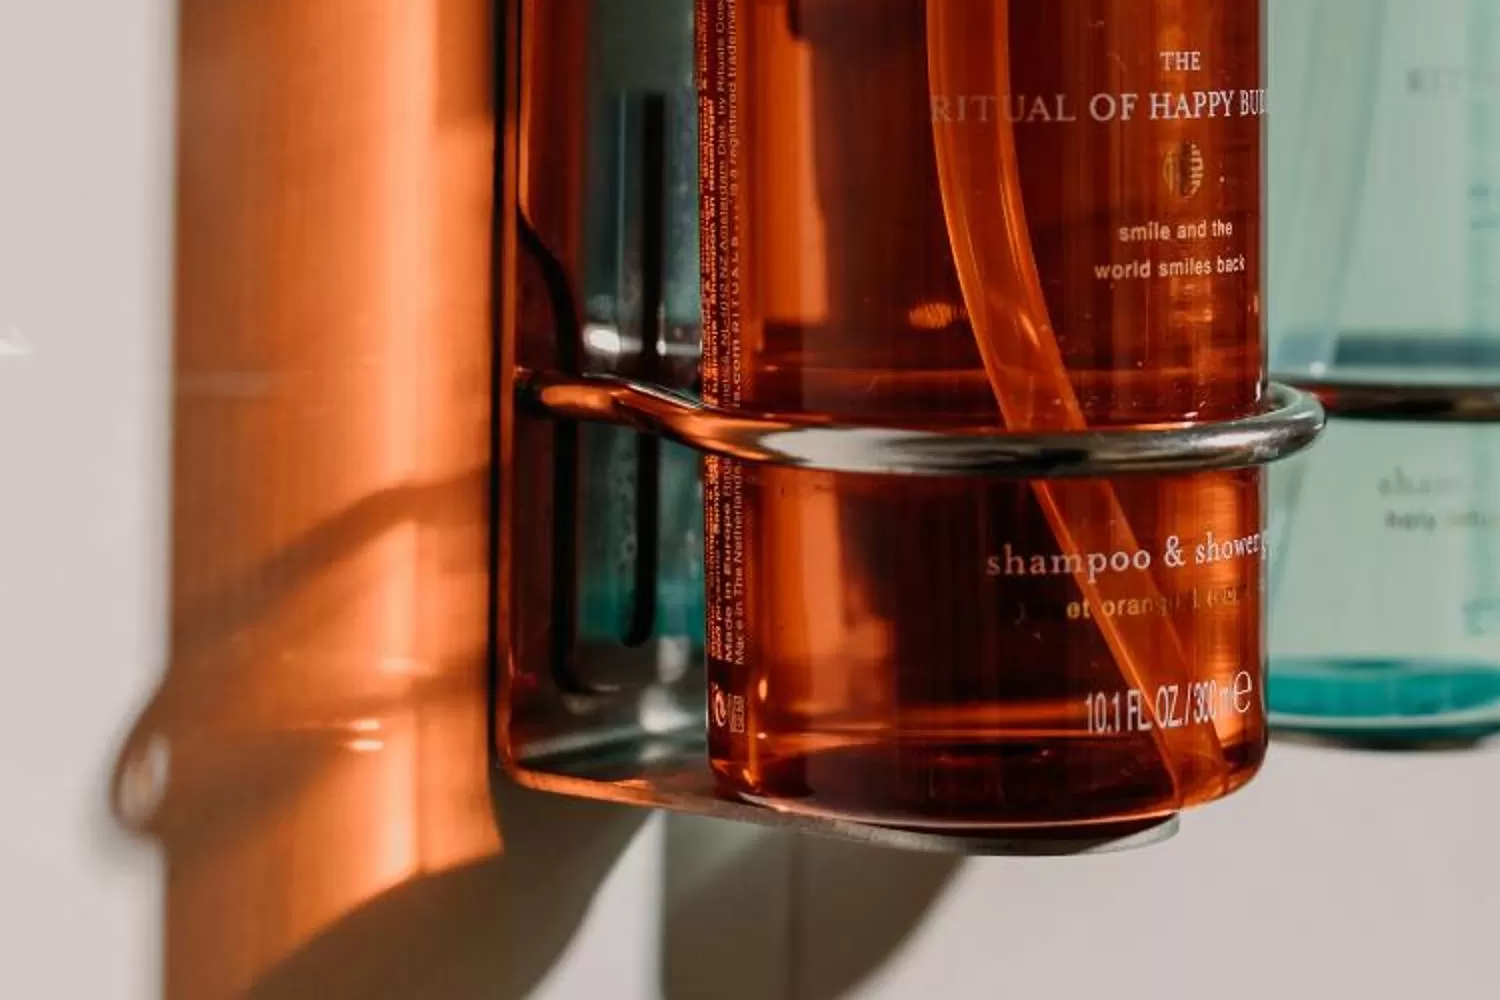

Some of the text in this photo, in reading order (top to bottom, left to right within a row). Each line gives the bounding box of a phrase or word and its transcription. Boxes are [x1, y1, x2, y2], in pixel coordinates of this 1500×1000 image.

[1160, 52, 1201, 71] THE
[717, 97, 727, 115] by
[931, 94, 1076, 123] RITUAL
[1089, 92, 1138, 121] OF
[1149, 90, 1235, 120] HAPPY
[1119, 219, 1233, 241] smile and the
[1094, 254, 1245, 280] world smiles back
[986, 544, 1151, 583] shampoo
[1164, 535, 1186, 568] &
[733, 567, 744, 596] The
[1084, 690, 1120, 735] 10.1
